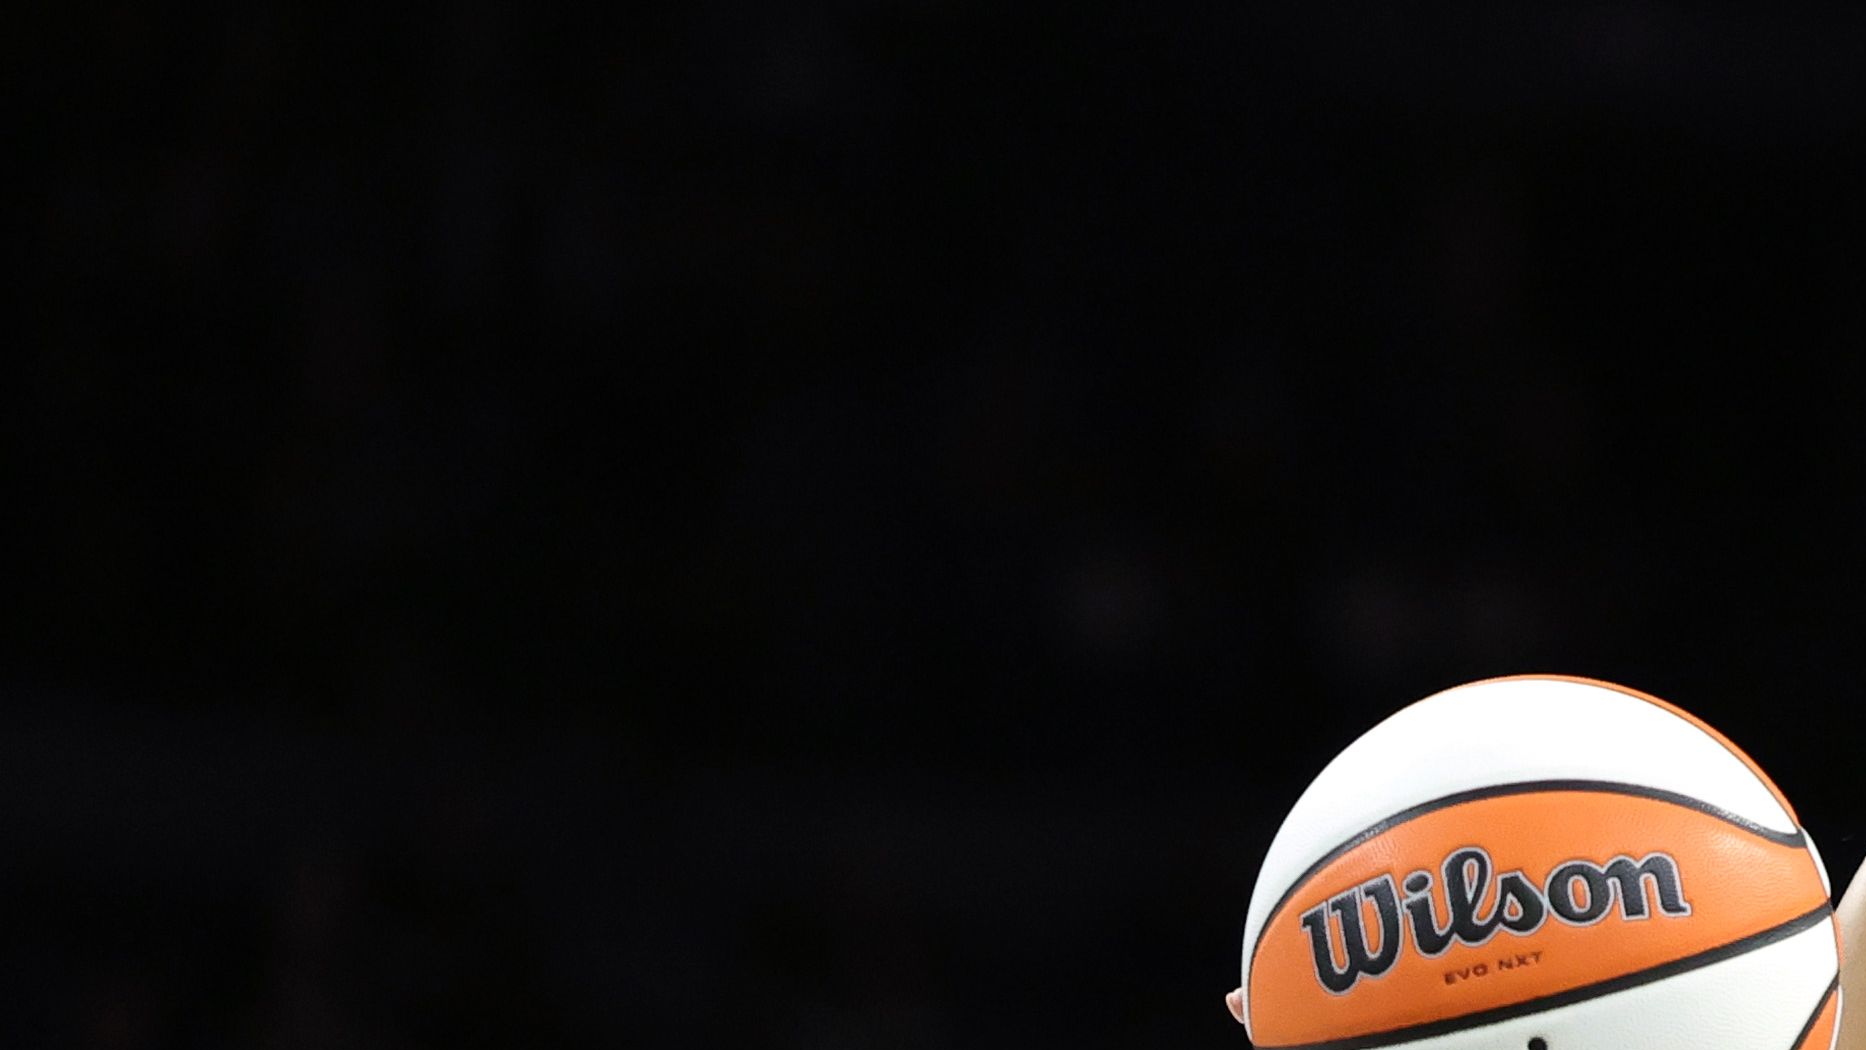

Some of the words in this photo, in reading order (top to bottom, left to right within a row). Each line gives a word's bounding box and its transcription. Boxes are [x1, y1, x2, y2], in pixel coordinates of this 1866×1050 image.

[1301, 846, 1692, 995] Wilson
[1444, 963, 1489, 986] EVO
[1498, 951, 1543, 971] NXT
